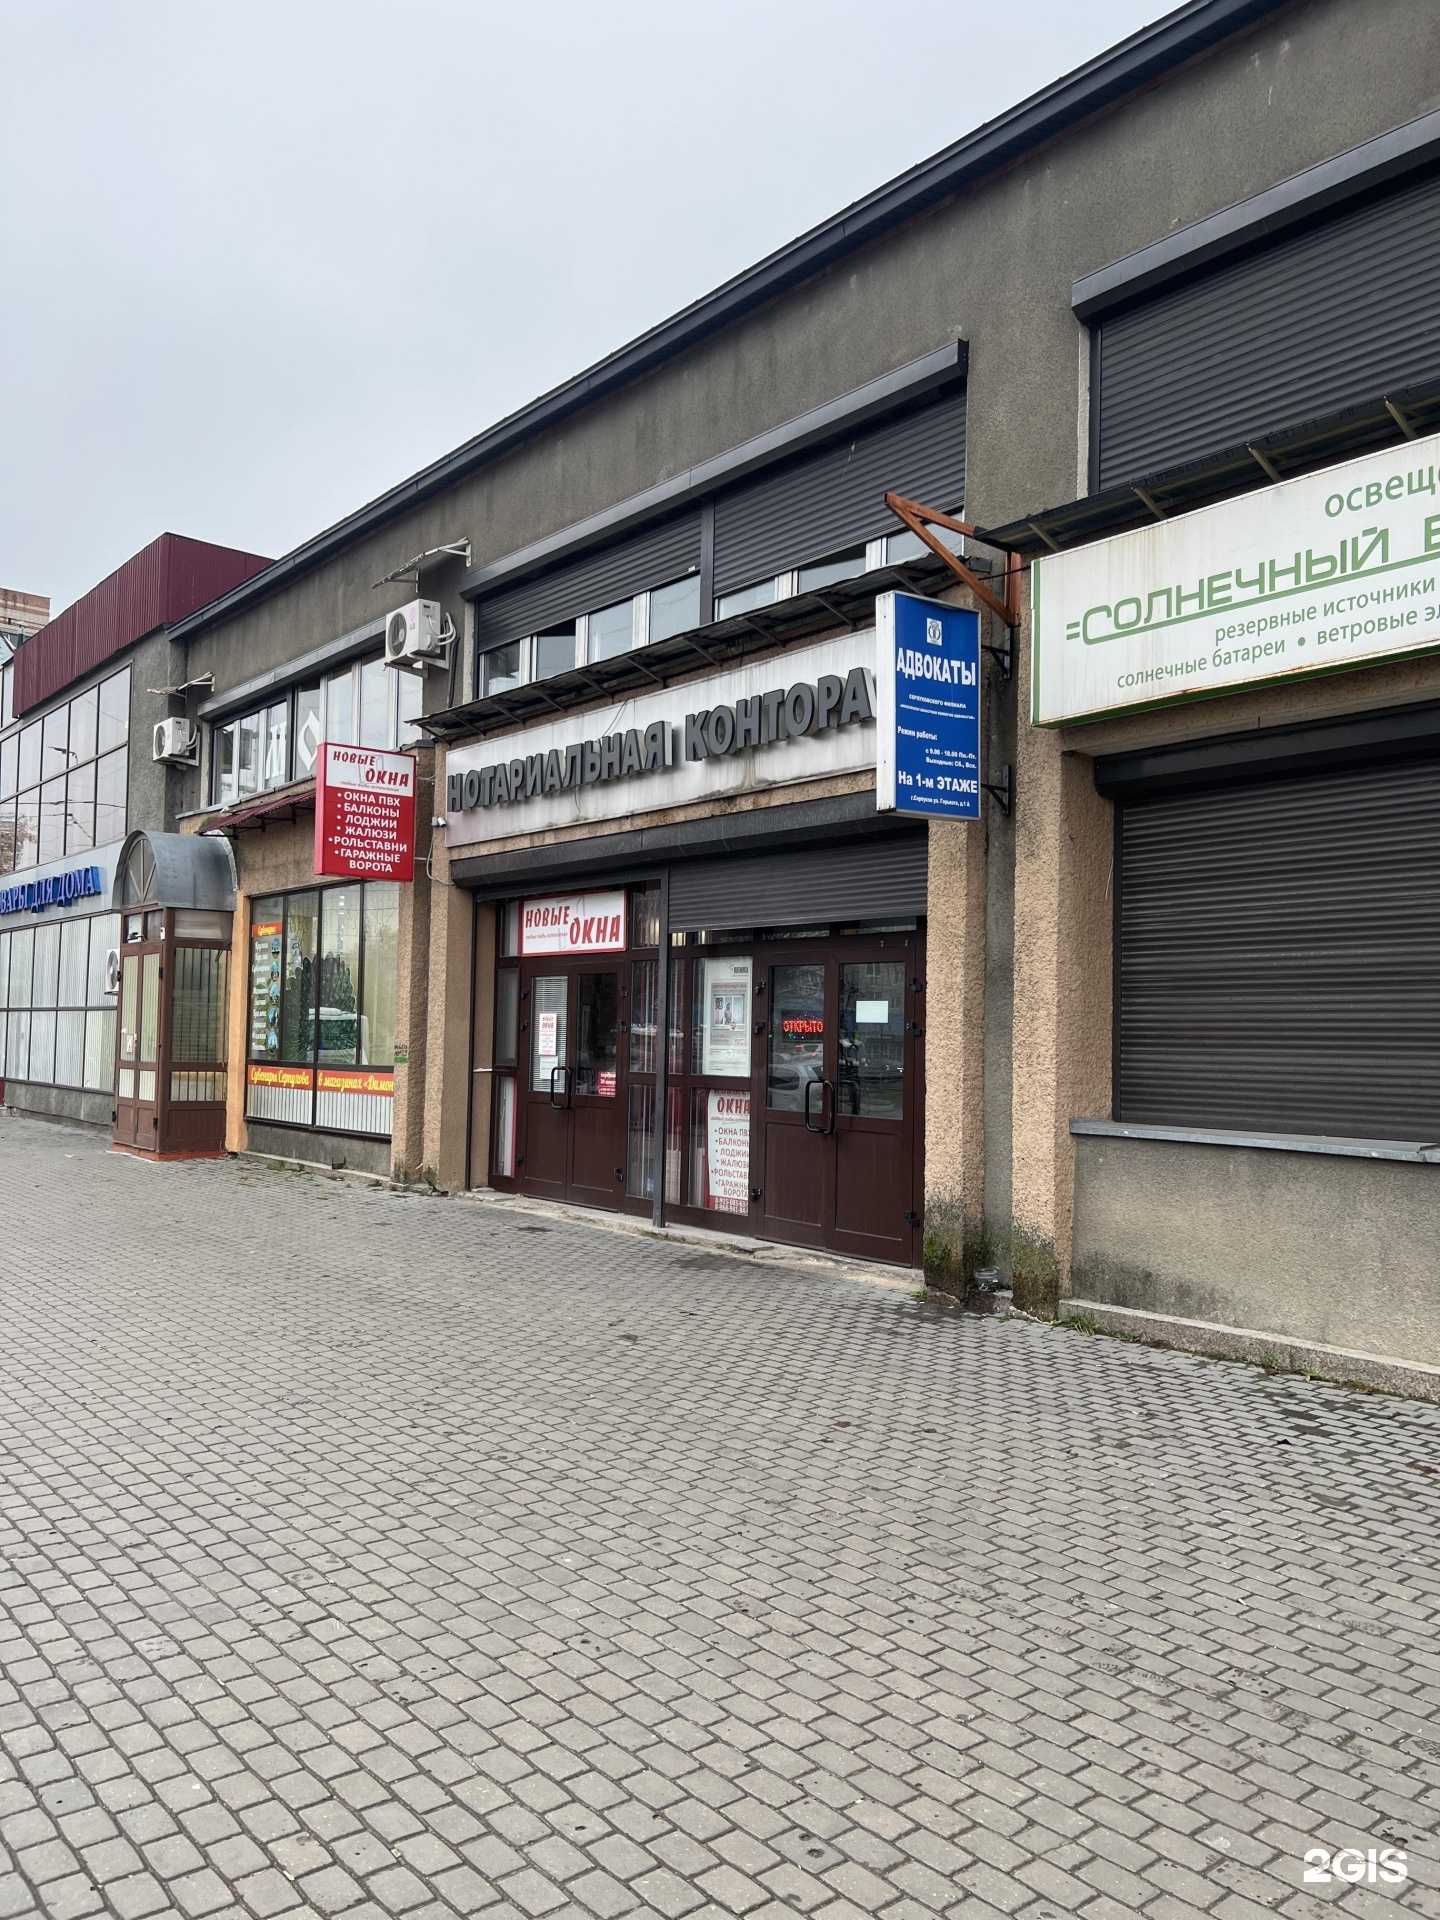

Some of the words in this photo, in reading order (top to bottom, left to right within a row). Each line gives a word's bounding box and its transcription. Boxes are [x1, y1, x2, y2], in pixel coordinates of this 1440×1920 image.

[1325, 465, 1440, 518] освещ
[1082, 526, 1389, 645] СОЛНЕЧНЫЙ
[1215, 606, 1317, 646] резервные
[1323, 577, 1435, 617] источники
[1117, 656, 1207, 689] солнечные
[1212, 639, 1285, 668] батареи
[1317, 609, 1418, 646] ветровые
[896, 647, 976, 687] АДВОКАТЫ
[447, 720, 673, 813] НОТАРИАЛЬНАЯ
[685, 667, 876, 762] КОНТОРА
[333, 751, 376, 767] НОВЫЕ
[365, 768, 410, 787] ОКНА
[898, 770, 913, 786] На
[915, 773, 934, 789] 1-м
[937, 776, 978, 794] ЭТАЖЕ
[343, 791, 376, 804] ОКНА
[378, 795, 401, 807] ПВХ
[343, 803, 400, 818] БАЛКОНЫ
[345, 814, 397, 829] ЛОДЖИИ
[345, 826, 397, 840] ЖАЛЮЗИ
[333, 837, 408, 852] РОЛЬСТАВНИ
[340, 848, 401, 863] ГАРАЖНЫЕ
[349, 860, 393, 873] ВОРОТА
[30, 877, 56, 911] ДЛЯ
[57, 866, 98, 906] ДОМА
[525, 906, 570, 928] НОВЫЕ
[569, 914, 622, 945] ОКНА
[783, 1020, 824, 1033] ОТКРЫТО
[717, 1097, 752, 1115] ОКНА
[718, 1127, 738, 1136] ОКНА
[739, 1128, 750, 1137] ПВ
